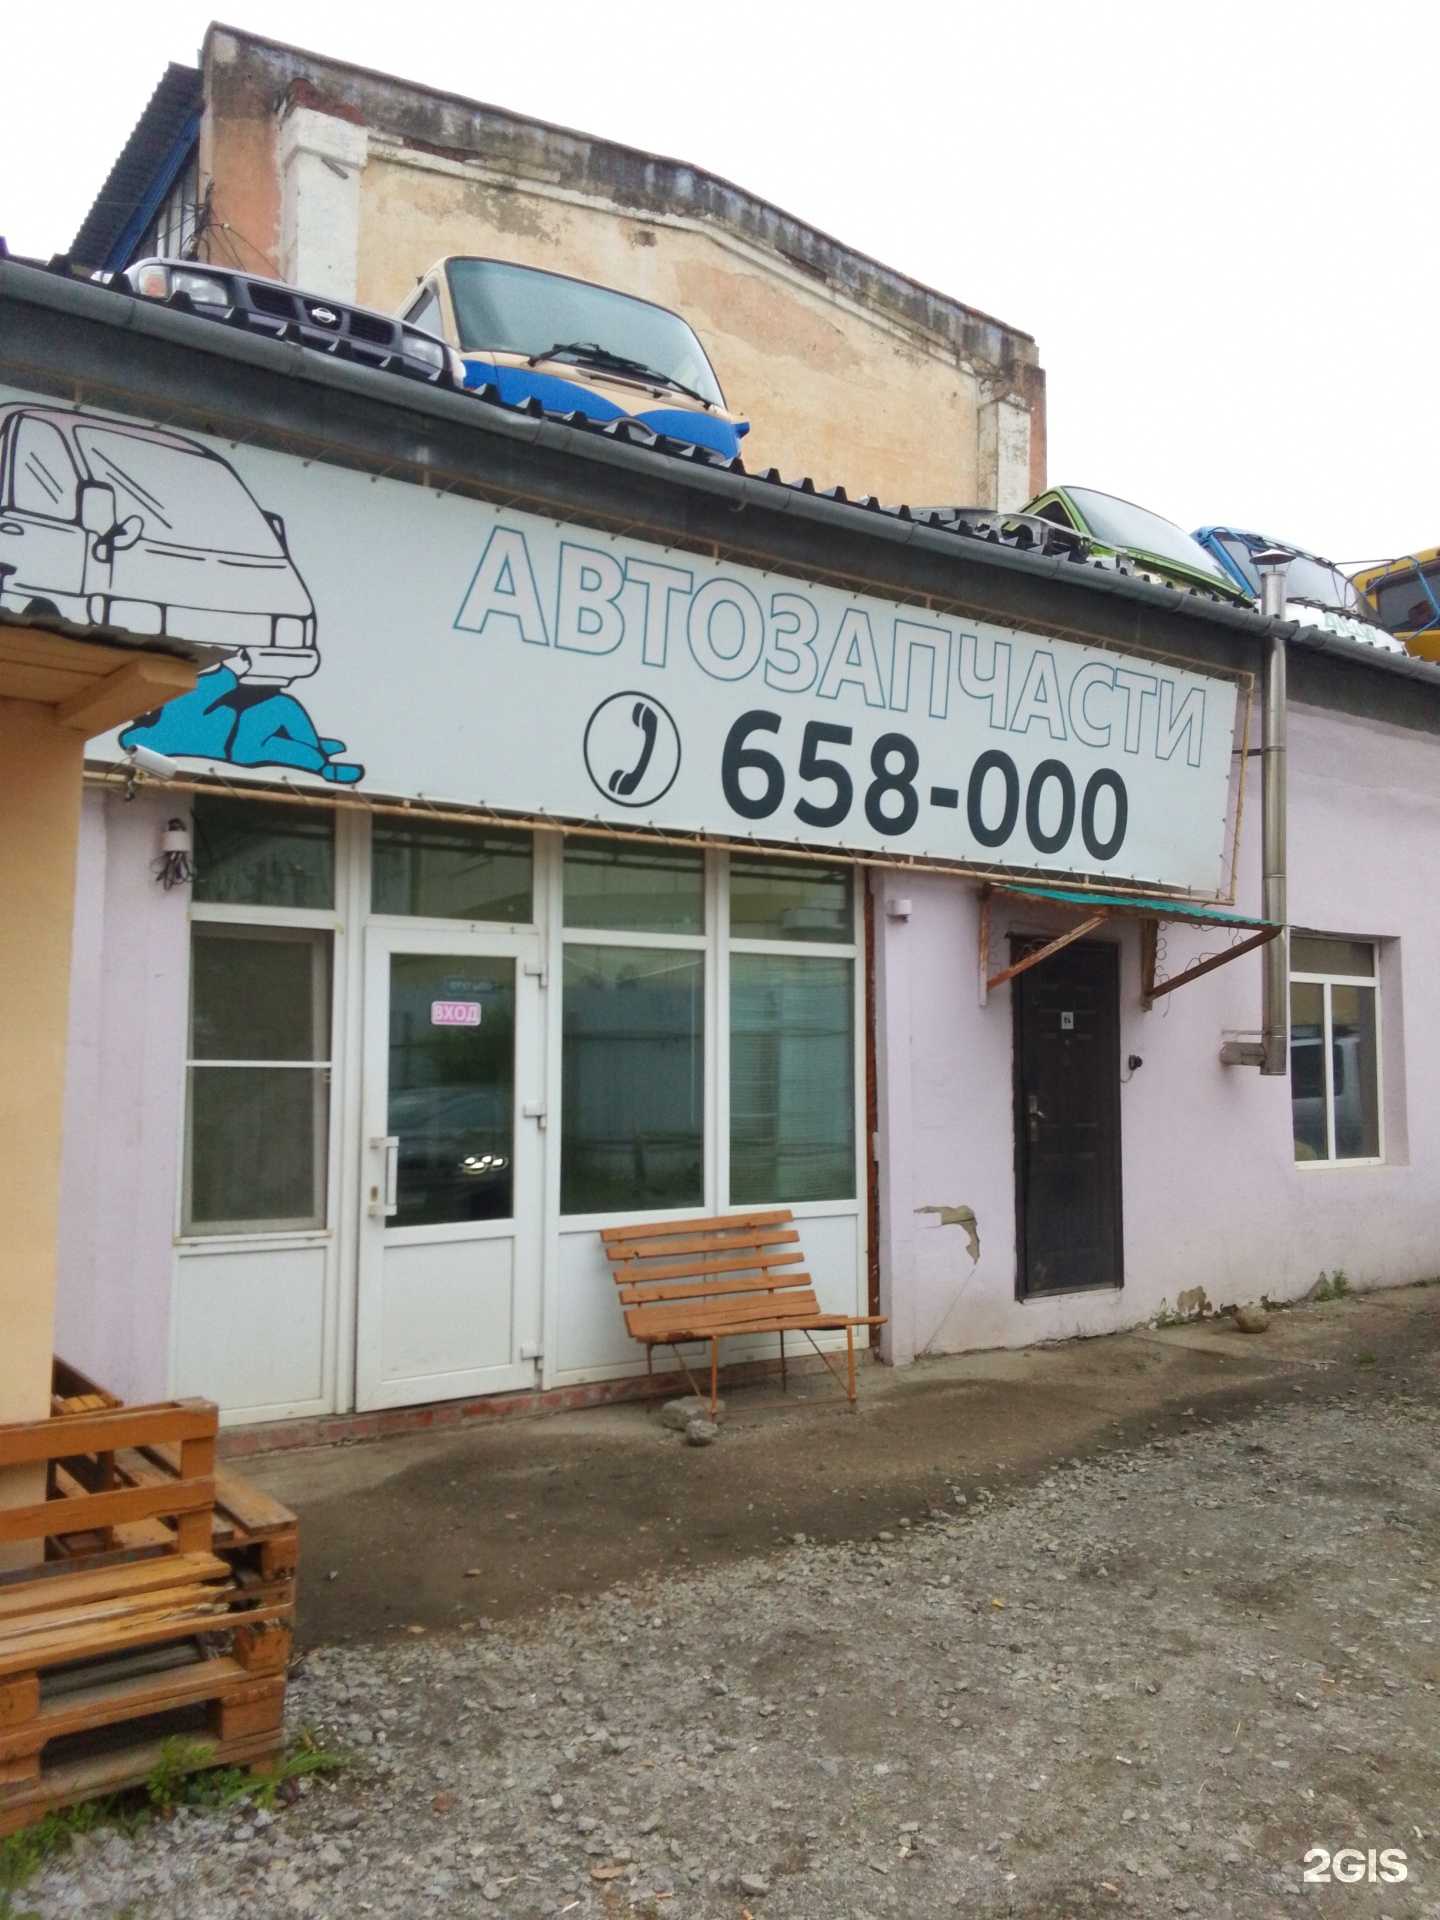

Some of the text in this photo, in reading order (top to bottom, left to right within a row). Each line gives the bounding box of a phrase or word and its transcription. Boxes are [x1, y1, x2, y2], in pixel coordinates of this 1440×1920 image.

[455, 526, 1206, 767] АВТОЗАПЧАСТИ
[721, 709, 1129, 861] 658-000
[434, 1003, 478, 1022] ВХОД
